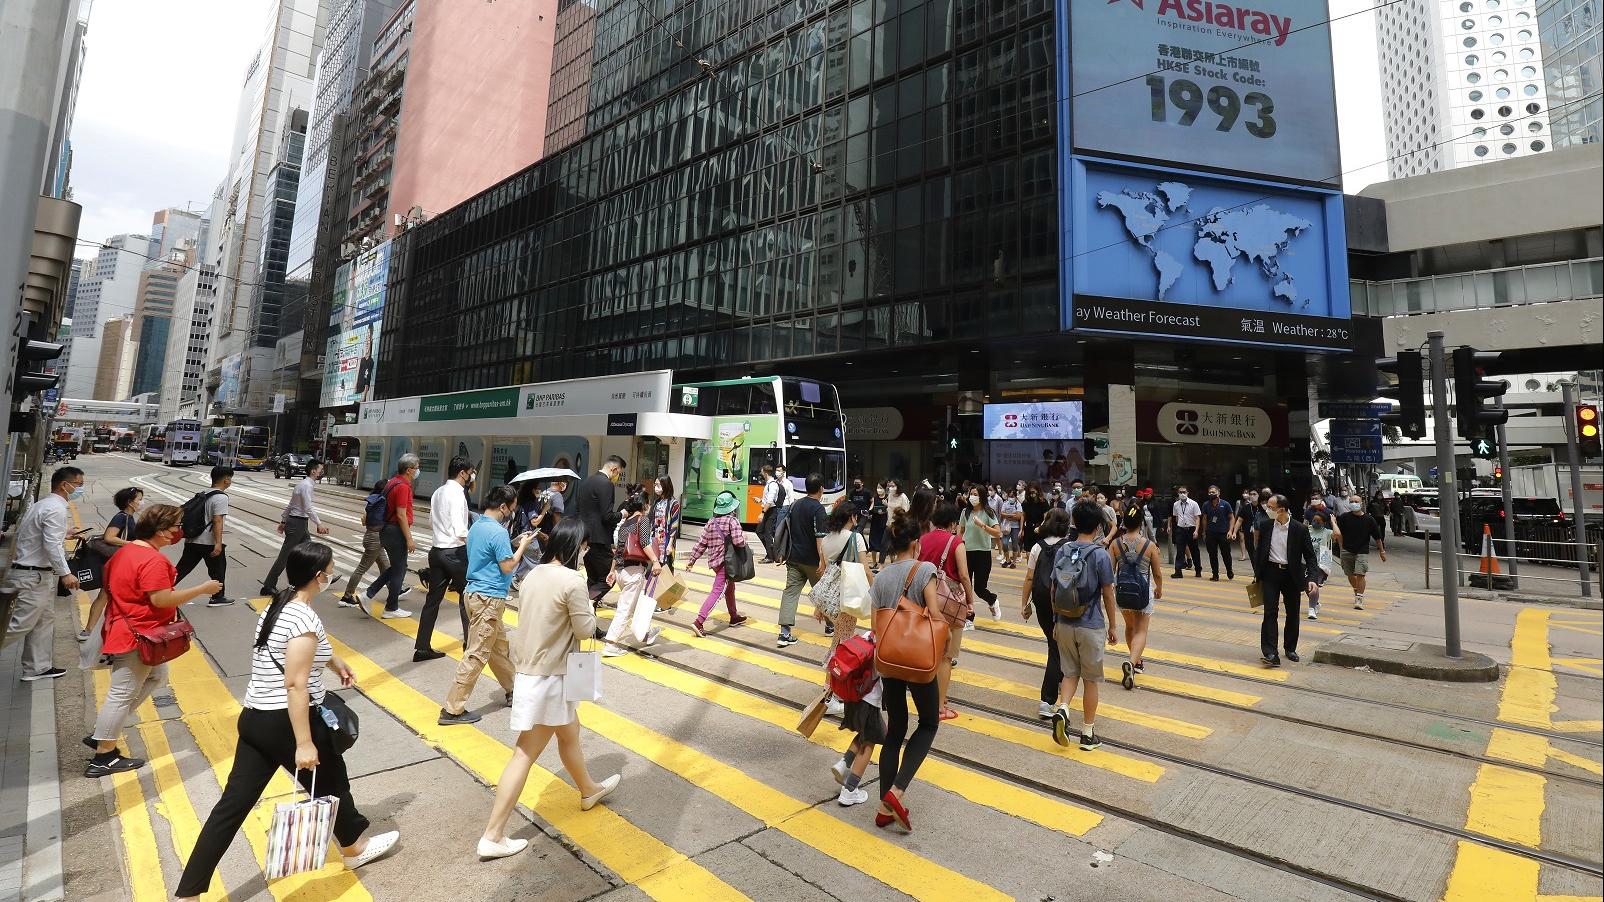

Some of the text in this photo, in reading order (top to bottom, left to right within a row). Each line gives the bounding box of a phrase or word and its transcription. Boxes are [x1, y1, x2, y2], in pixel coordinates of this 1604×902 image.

[1157, 18, 1272, 46] Inspiration Everywhere
[1158, 0, 1291, 46] Asiaray
[1157, 58, 1267, 87] HKSE Stock Code:
[1146, 75, 1277, 139] 1993
[1093, 306, 1146, 322] Weather
[1149, 311, 1200, 327] Forecast
[1241, 318, 1265, 333] 氣溫
[1272, 321, 1318, 337] Weather
[1021, 412, 1060, 421] 大新銀行
[1201, 411, 1256, 427] 大新銀行
